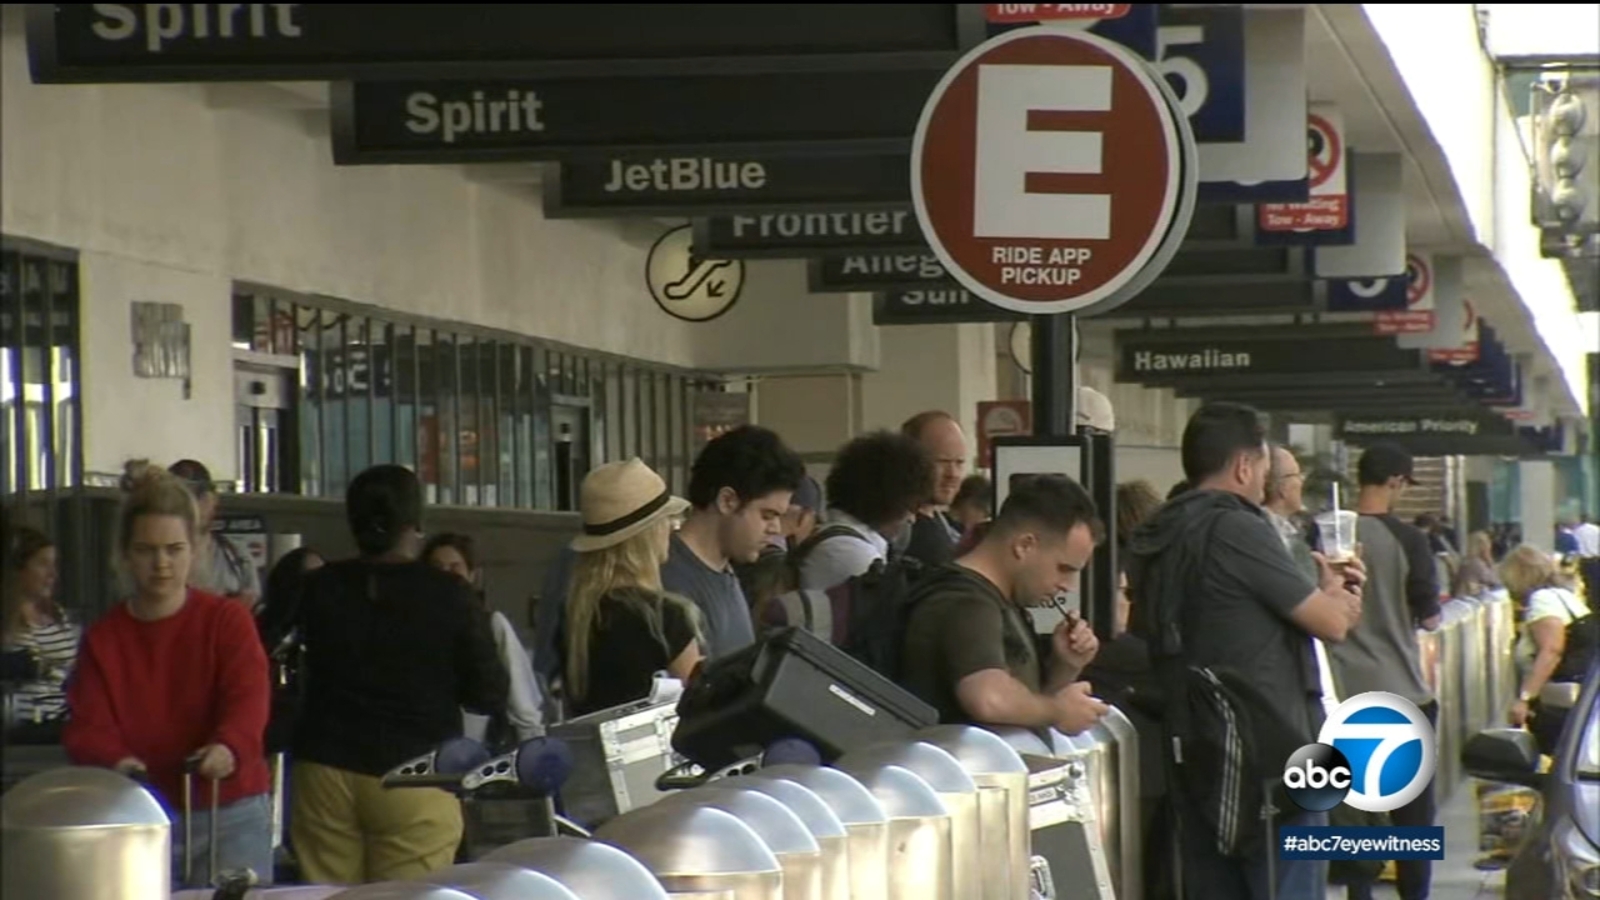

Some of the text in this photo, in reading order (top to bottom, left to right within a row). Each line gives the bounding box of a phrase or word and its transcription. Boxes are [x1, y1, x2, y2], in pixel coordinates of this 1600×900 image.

[92, 4, 301, 51] Spirit
[405, 91, 544, 142] Spirit
[974, 64, 1113, 240] E
[604, 158, 766, 192] JetBlue
[733, 210, 908, 237] Frontier
[992, 246, 1091, 265] RIDE APP
[1001, 266, 1082, 286] PICKUP
[1134, 349, 1251, 371] Hawaiian
